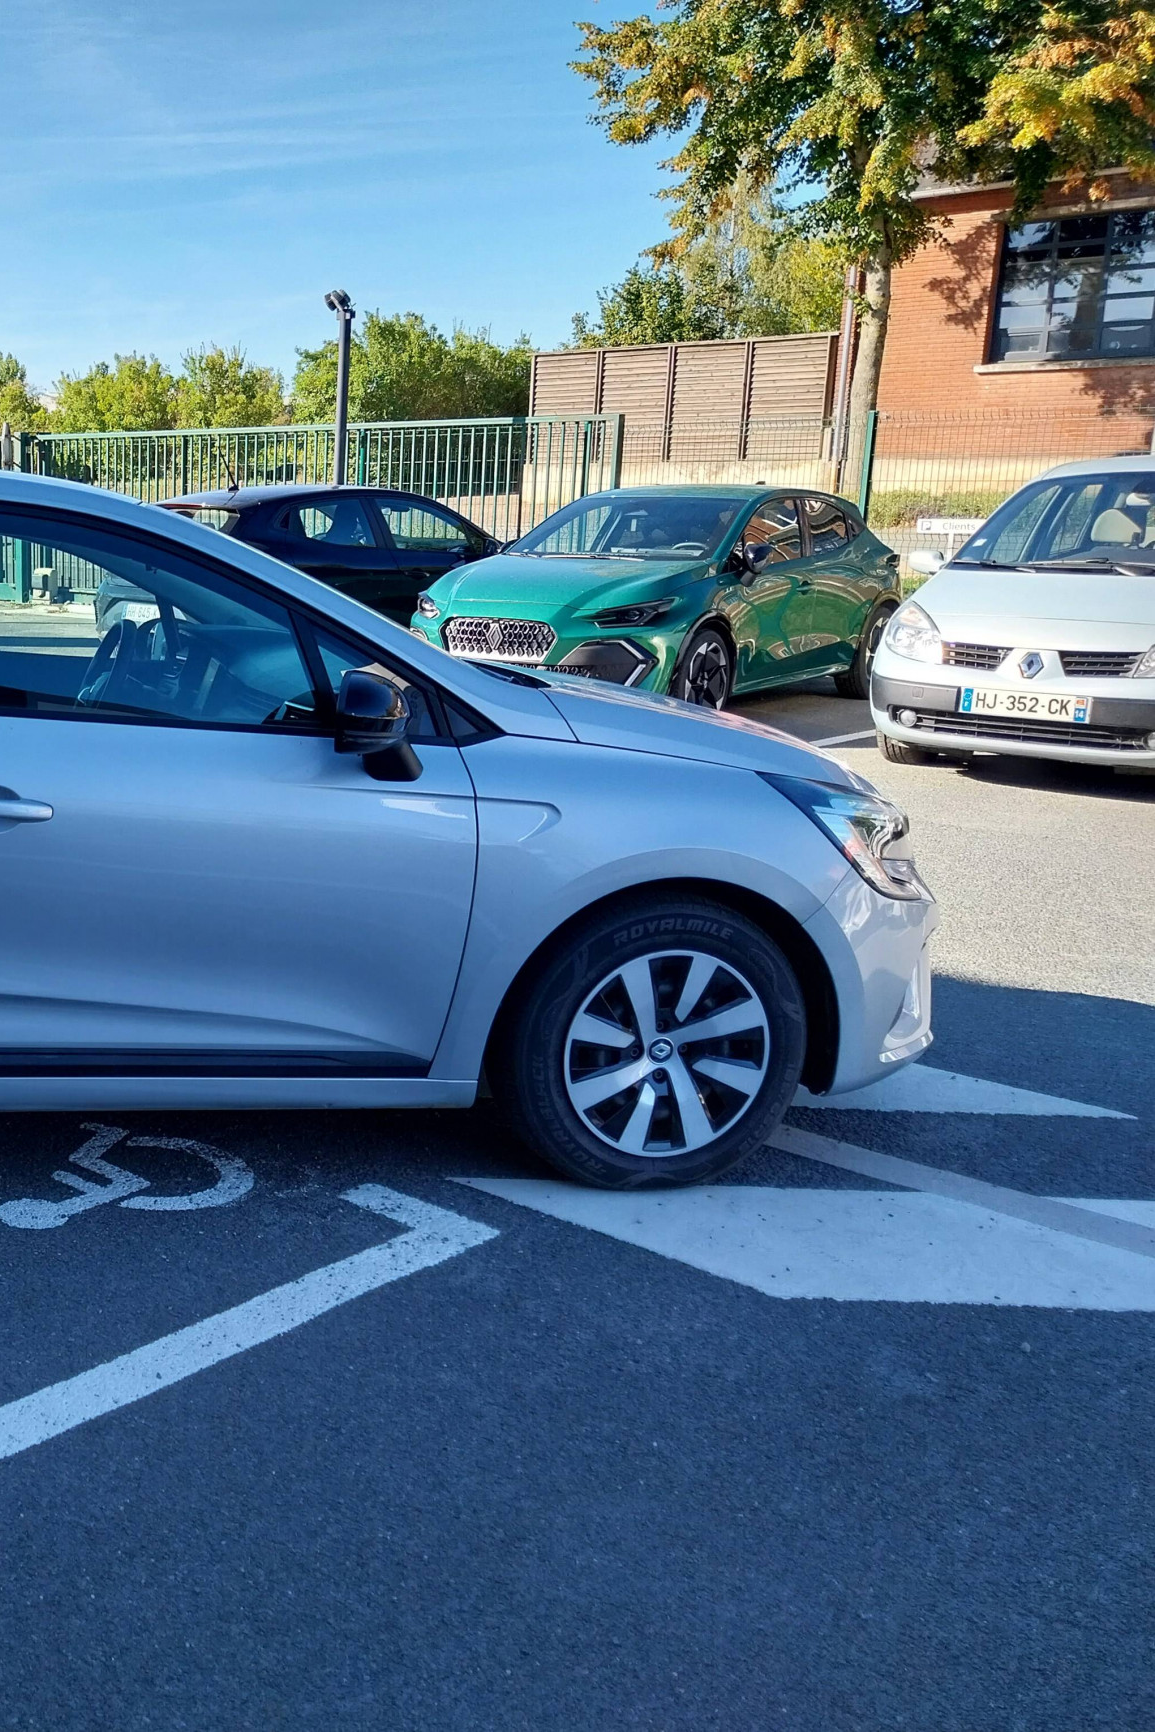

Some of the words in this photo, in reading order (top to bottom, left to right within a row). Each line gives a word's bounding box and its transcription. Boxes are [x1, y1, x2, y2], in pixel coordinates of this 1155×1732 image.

[942, 522, 976, 531] Clients
[975, 692, 1071, 716] HJ-352-CK
[1074, 709, 1085, 719] 14
[613, 918, 734, 946] ROYALMILE
